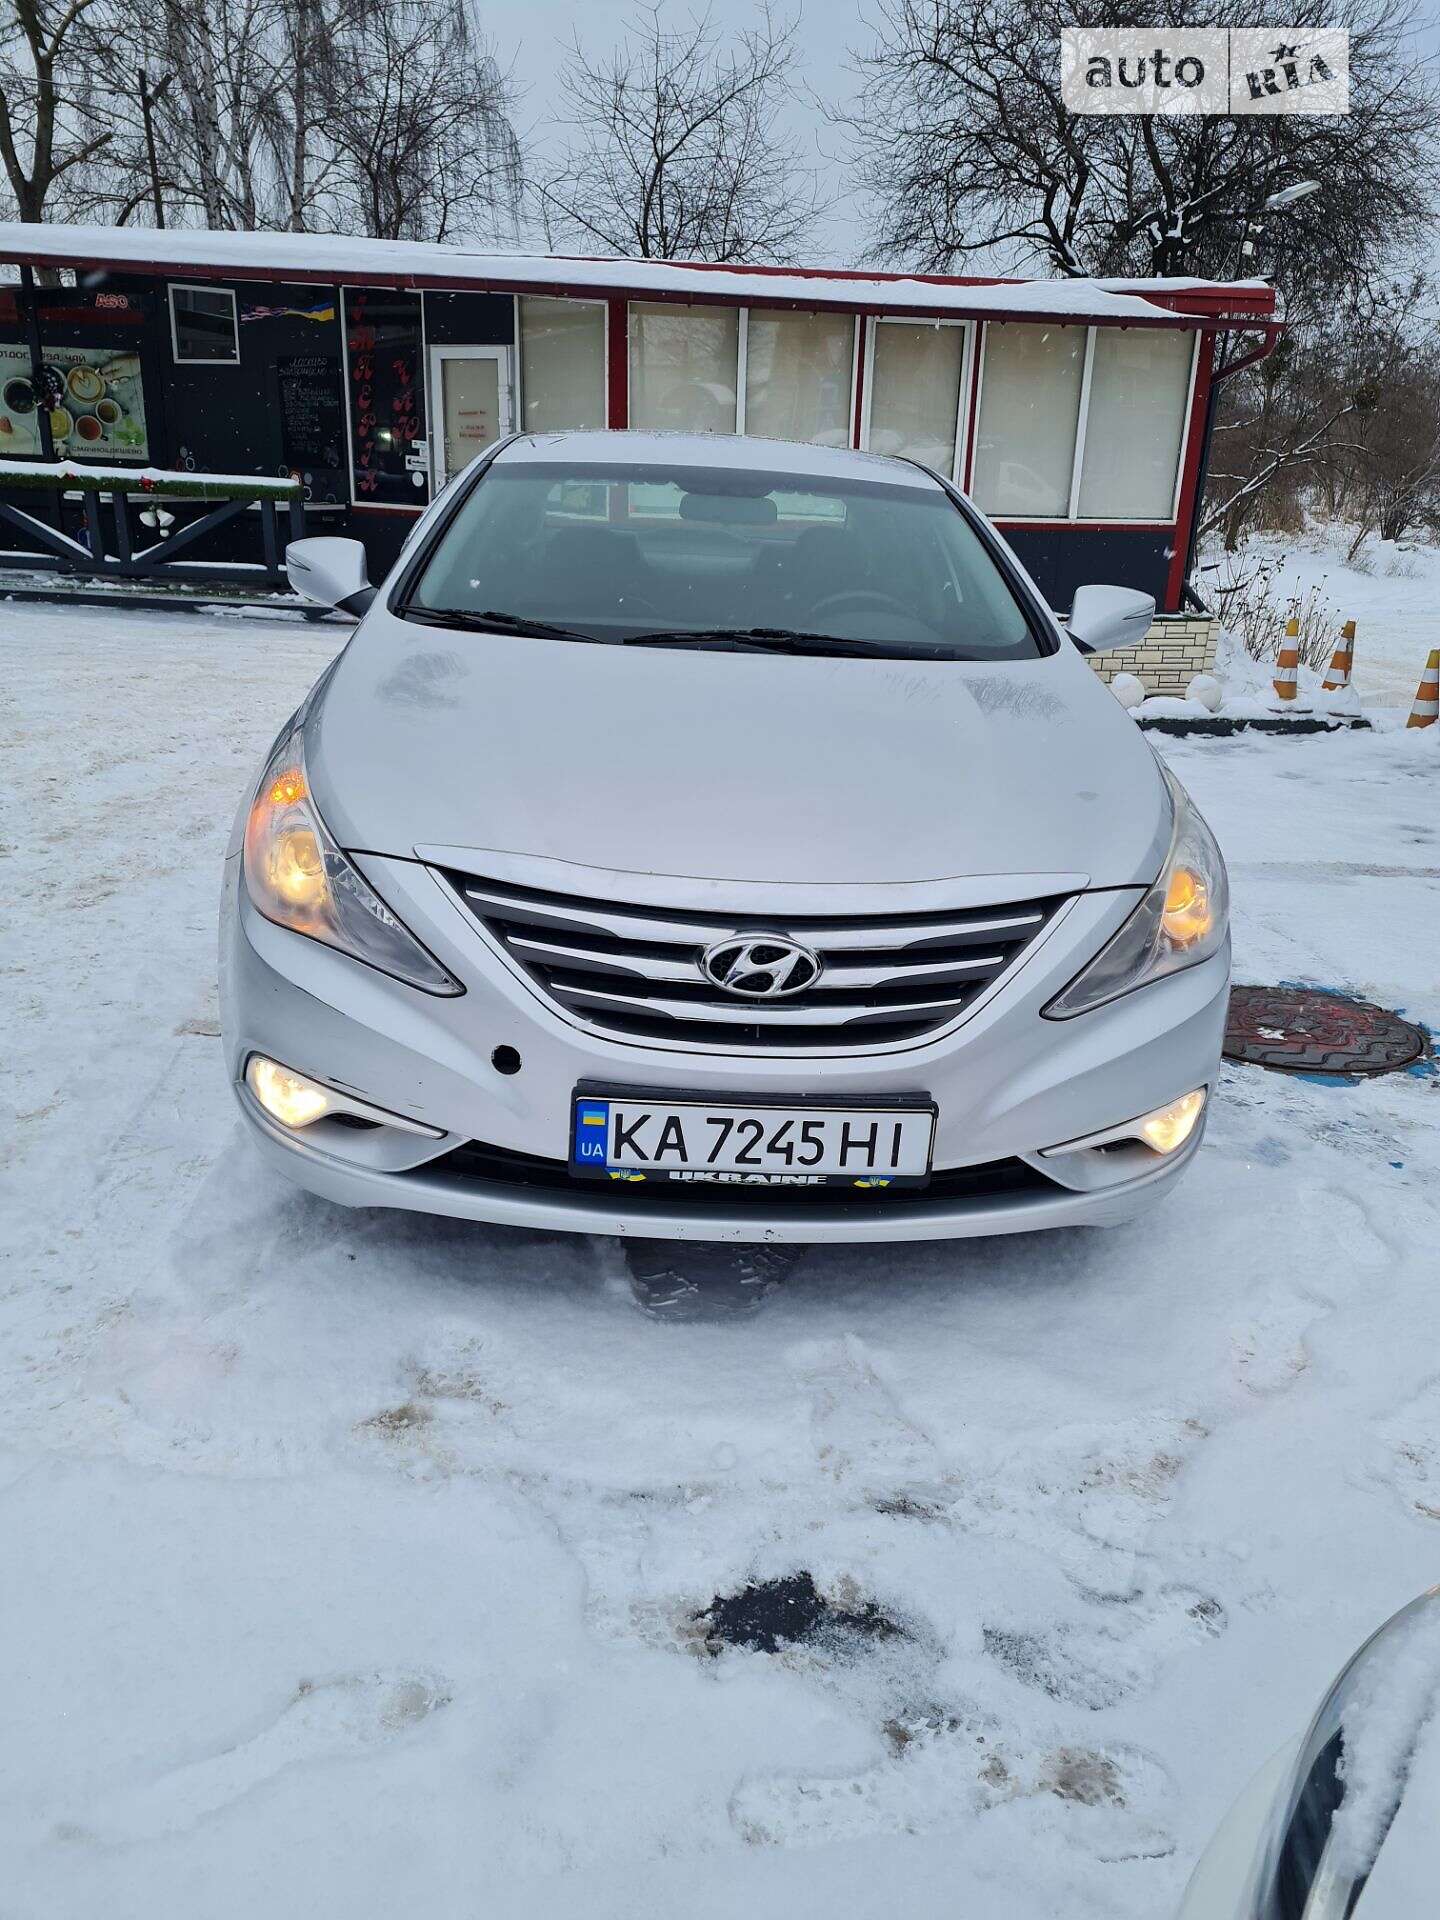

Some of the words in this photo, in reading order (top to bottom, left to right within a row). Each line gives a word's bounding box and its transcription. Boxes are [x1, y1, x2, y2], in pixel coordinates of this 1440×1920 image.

[612, 1112, 689, 1163] KA
[706, 1117, 826, 1166] 7245
[839, 1121, 903, 1168] HI
[581, 1142, 604, 1158] UA
[668, 1170, 828, 1186] UKRAINE
